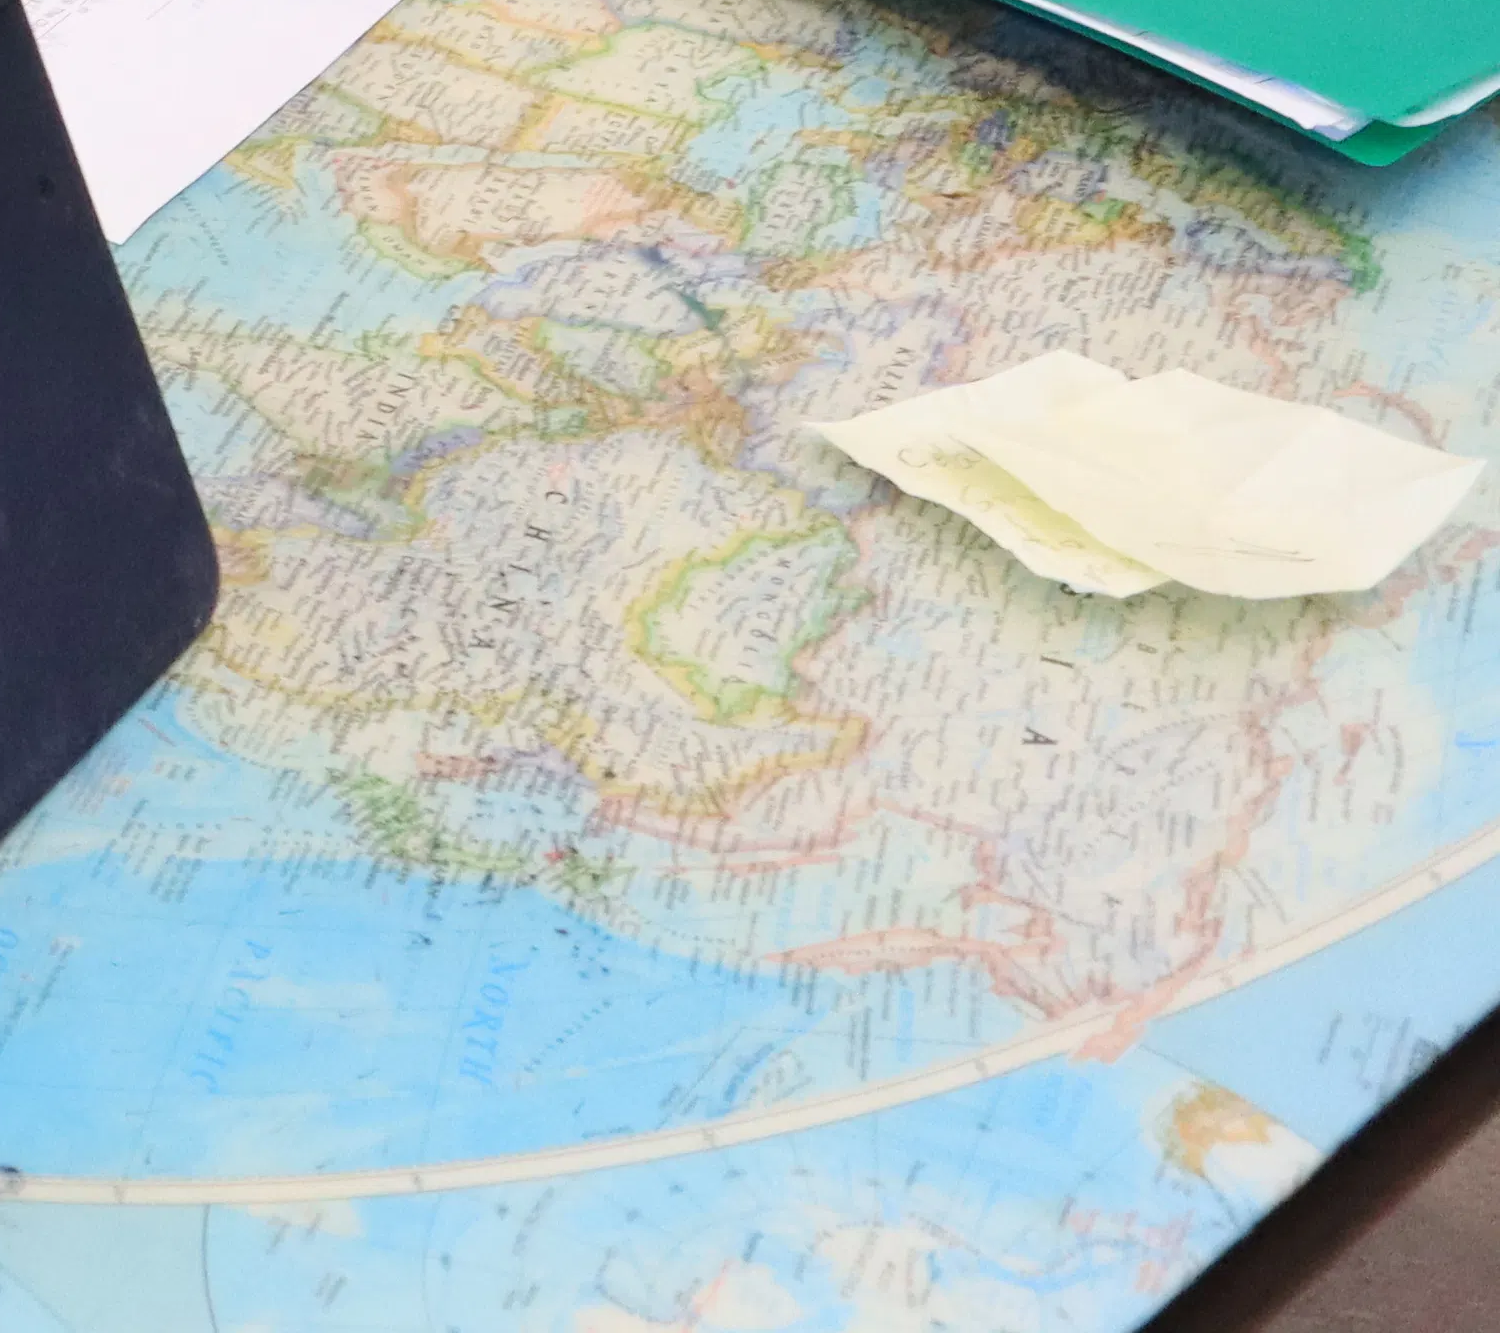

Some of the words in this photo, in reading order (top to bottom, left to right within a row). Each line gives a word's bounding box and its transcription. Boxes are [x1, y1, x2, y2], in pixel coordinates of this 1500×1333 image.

[360, 372, 414, 446] INDIA
[467, 490, 567, 652] CHINA
[459, 940, 533, 1087] NORTH
